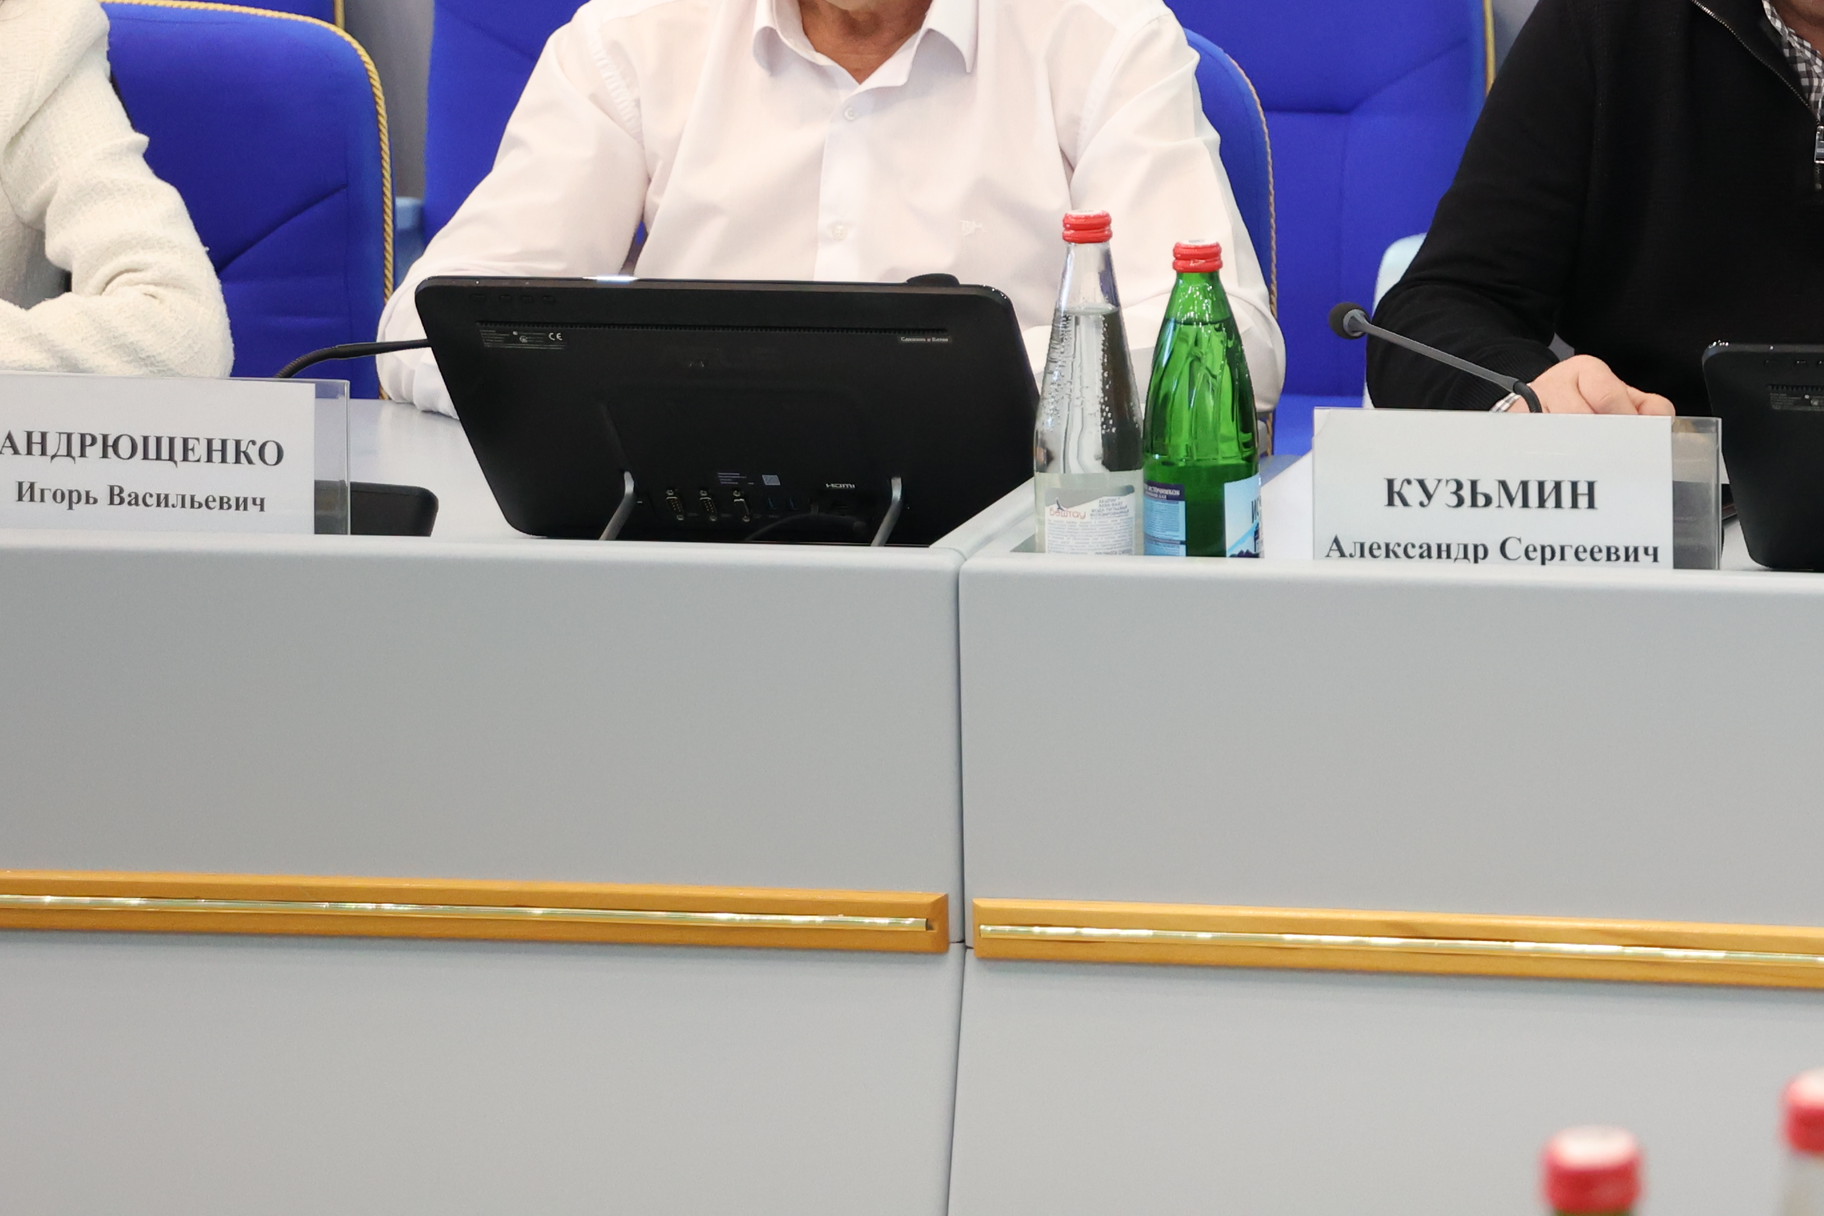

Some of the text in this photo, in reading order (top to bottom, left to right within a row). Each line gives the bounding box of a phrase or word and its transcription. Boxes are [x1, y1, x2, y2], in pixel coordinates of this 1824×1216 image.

[0, 429, 285, 468] АНДРЮЩЕНКО
[16, 480, 266, 513] Игорь Васильевич
[1384, 477, 1599, 511] КУЗЬМИН
[1325, 535, 1660, 566] Александр Сергеевич
